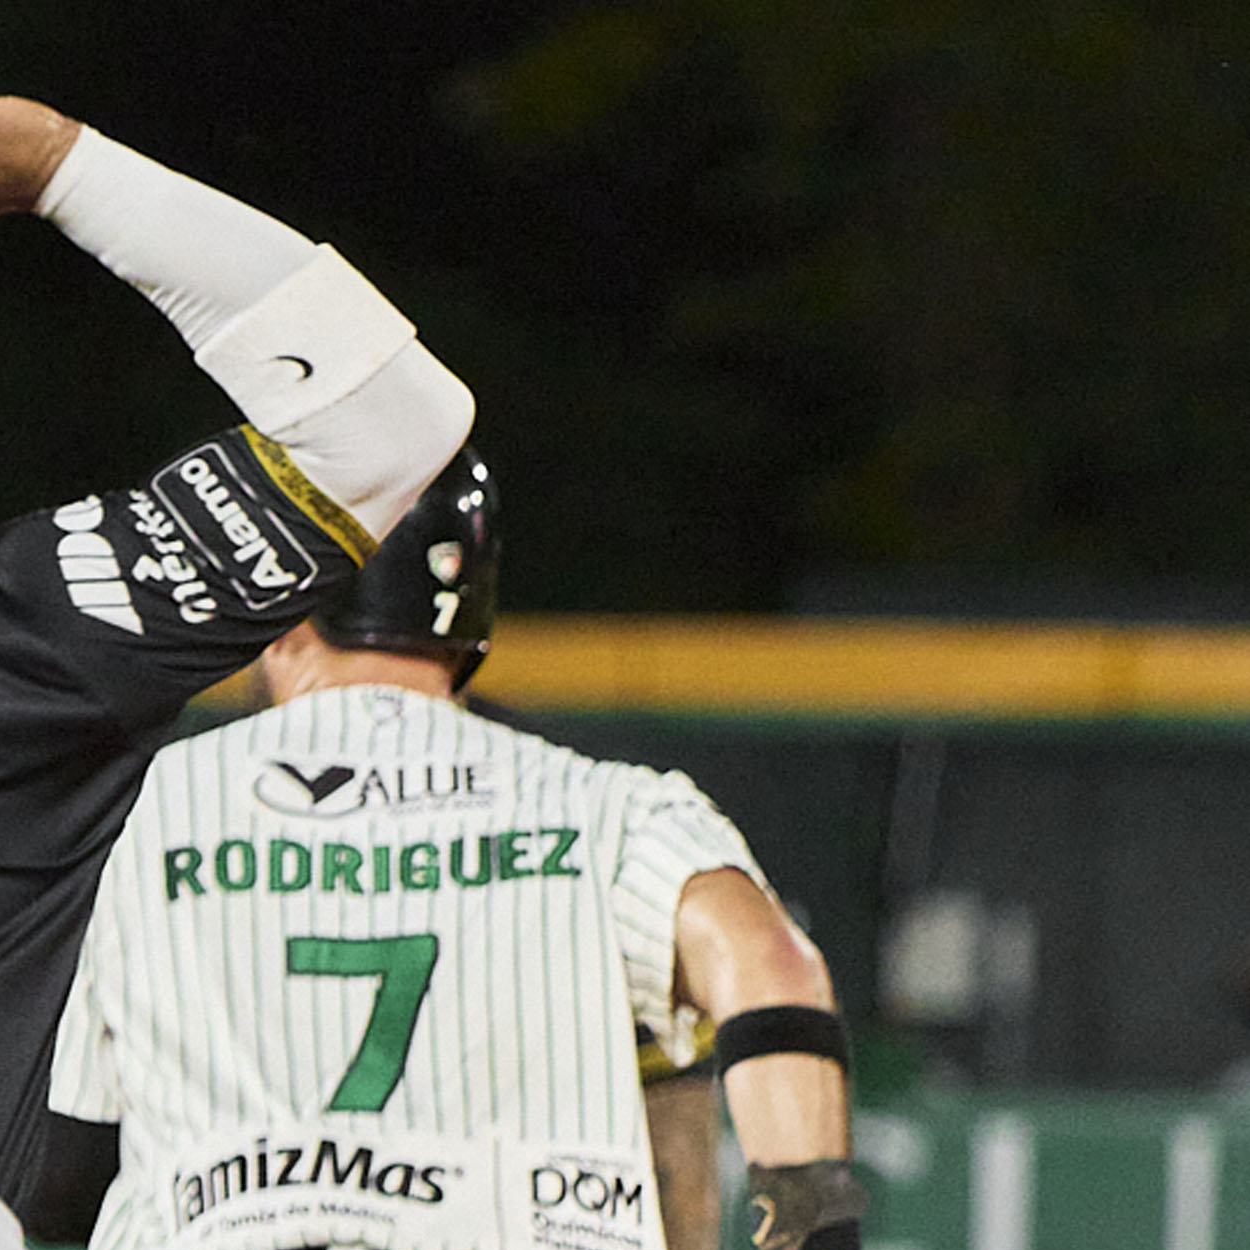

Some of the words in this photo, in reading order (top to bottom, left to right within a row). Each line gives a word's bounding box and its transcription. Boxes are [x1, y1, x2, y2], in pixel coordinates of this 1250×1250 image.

[178, 457, 298, 589] Alamo
[164, 828, 582, 901] RODRIGUEZ
[285, 932, 440, 1113] 7
